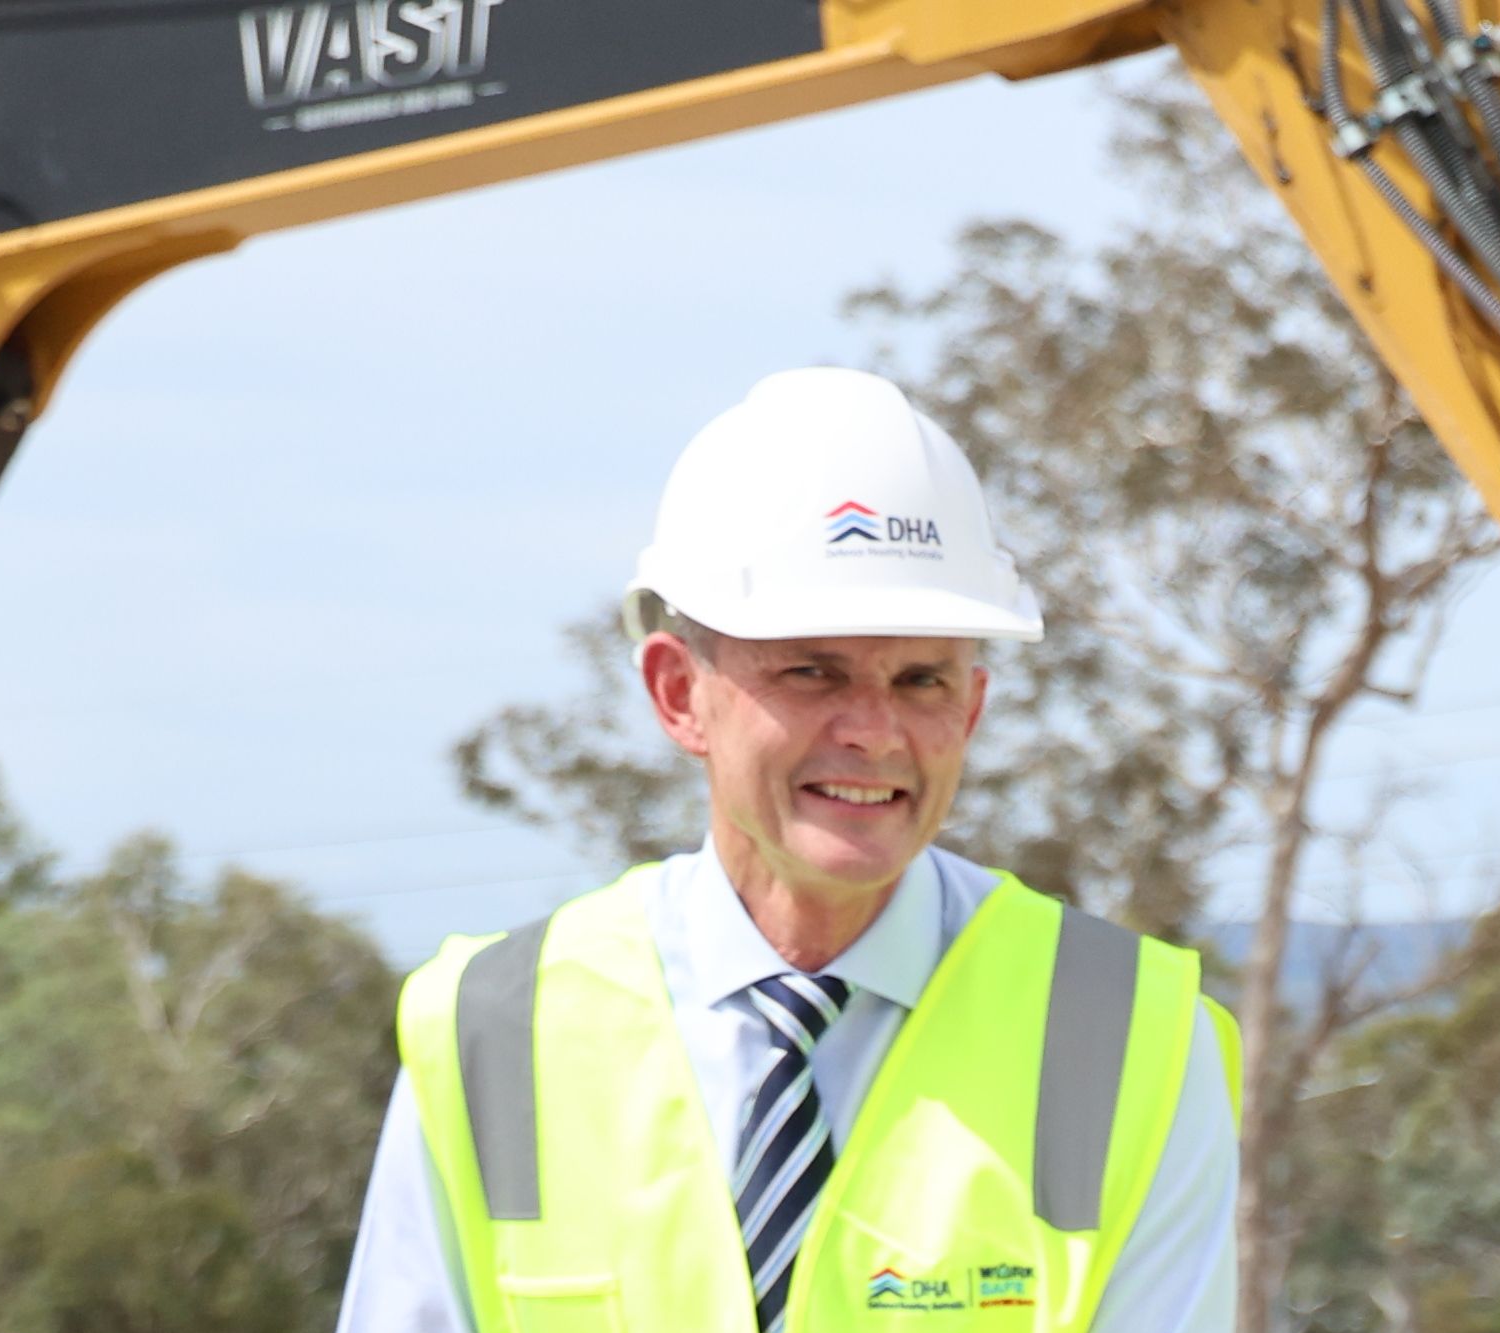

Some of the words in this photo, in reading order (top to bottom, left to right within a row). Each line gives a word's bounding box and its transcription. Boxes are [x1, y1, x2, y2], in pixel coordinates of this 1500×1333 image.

[238, 0, 500, 108] VAST
[887, 517, 941, 545] DHA
[912, 1280, 951, 1298] DHA
